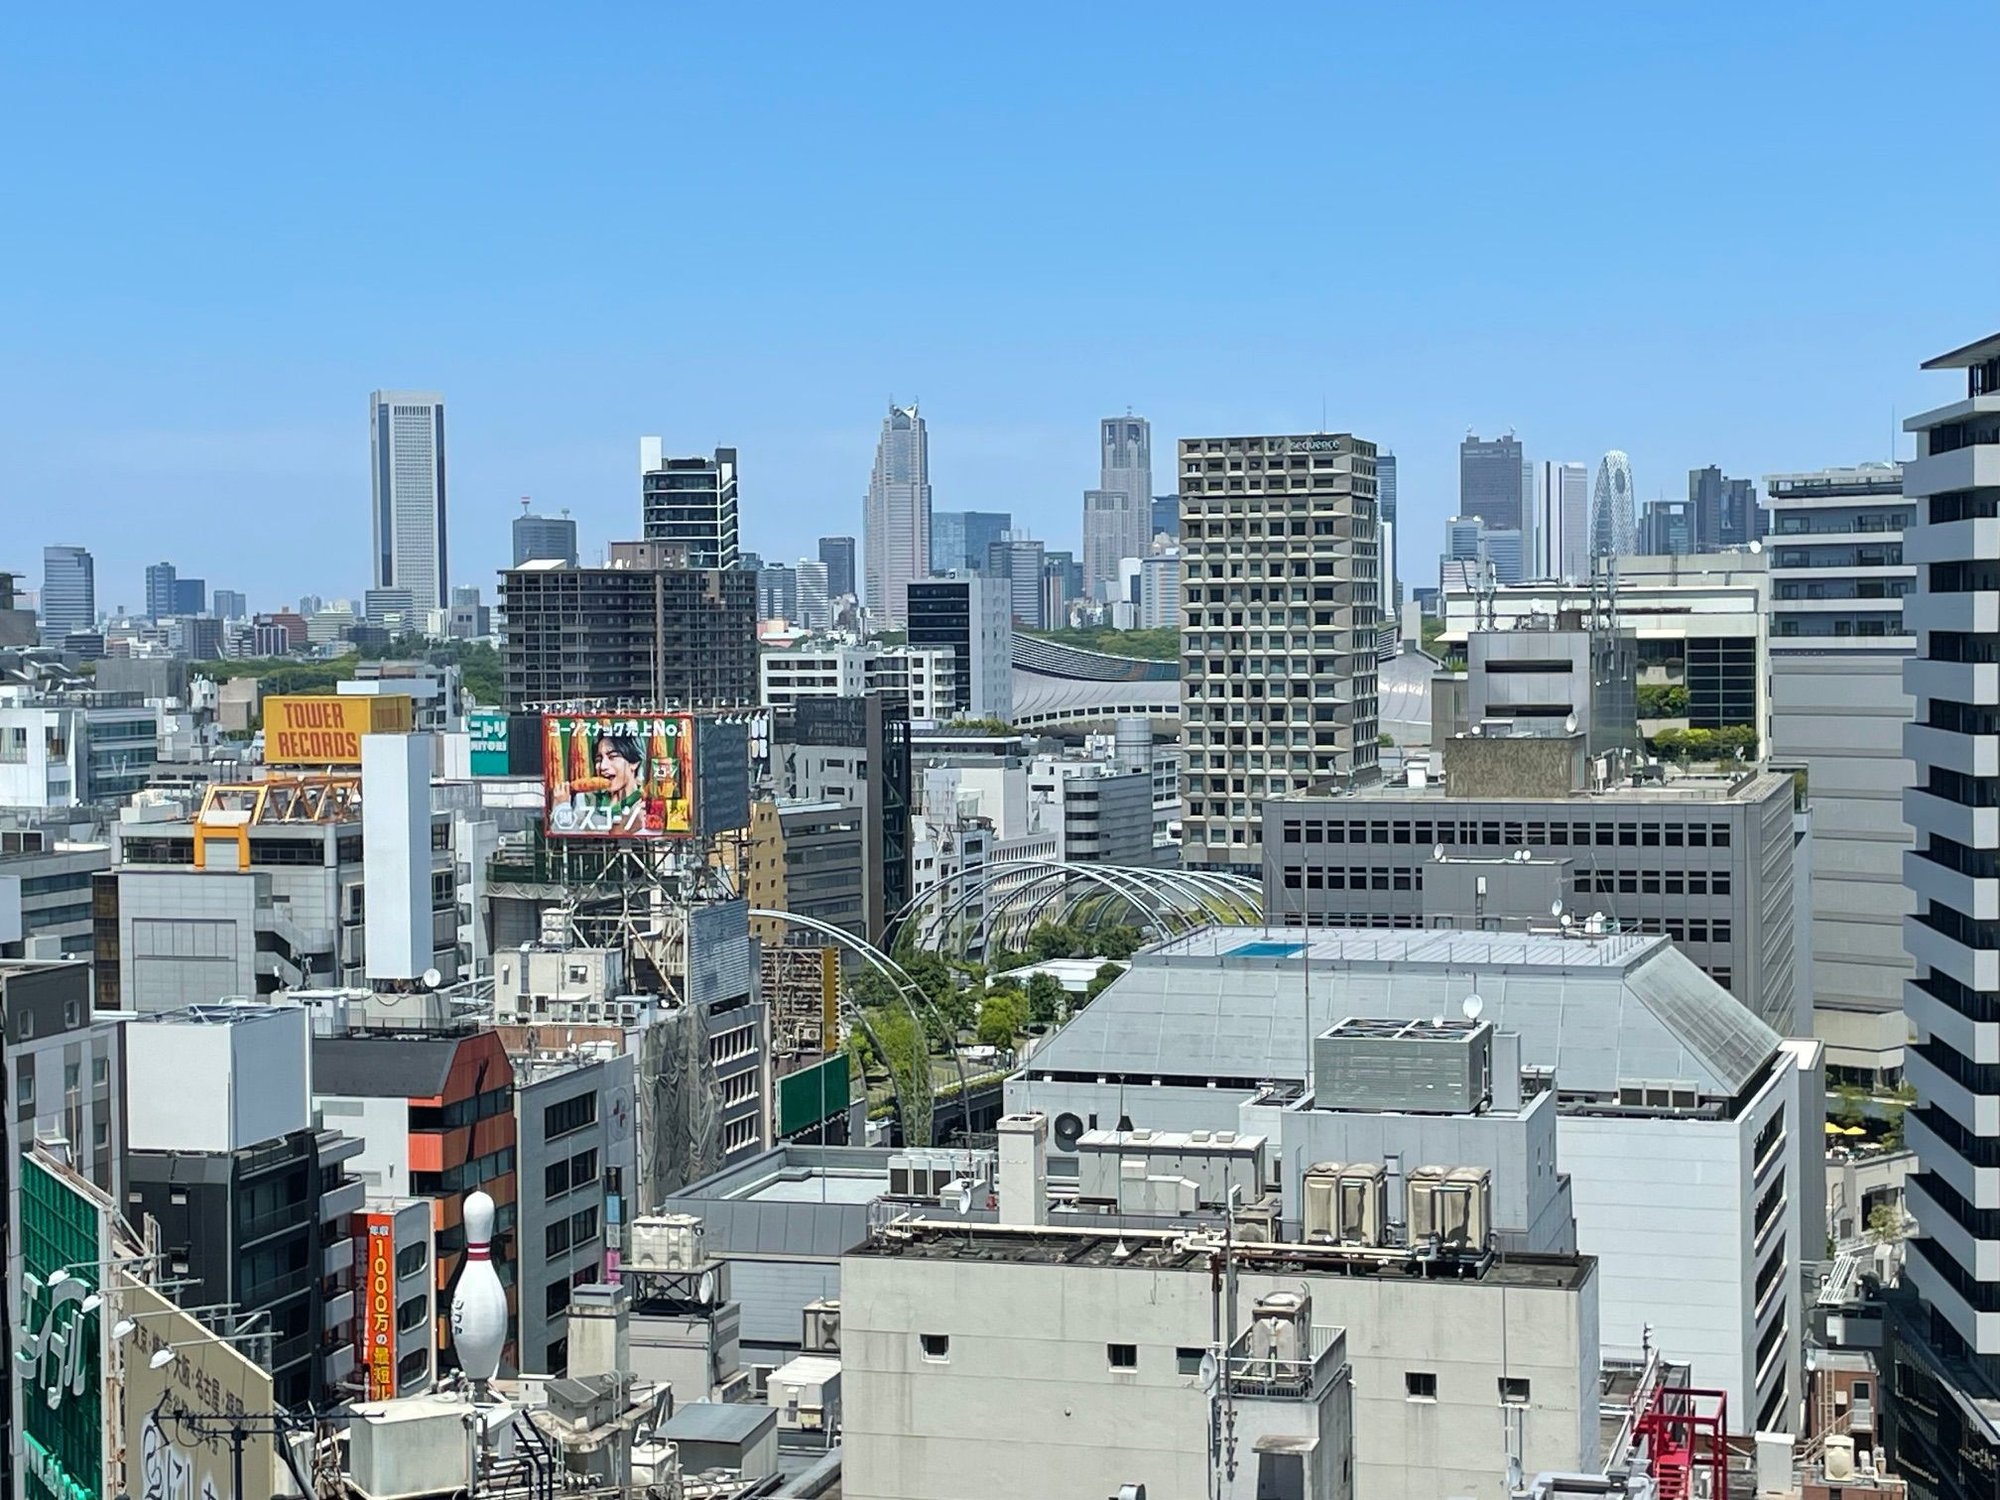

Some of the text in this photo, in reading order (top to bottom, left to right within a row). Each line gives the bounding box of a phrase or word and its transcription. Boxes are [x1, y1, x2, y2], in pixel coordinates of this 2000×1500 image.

[283, 703, 345, 729] TOWER
[470, 720, 507, 738] ニトリ
[278, 731, 359, 758] RECORDS
[579, 805, 643, 831] スコーン
